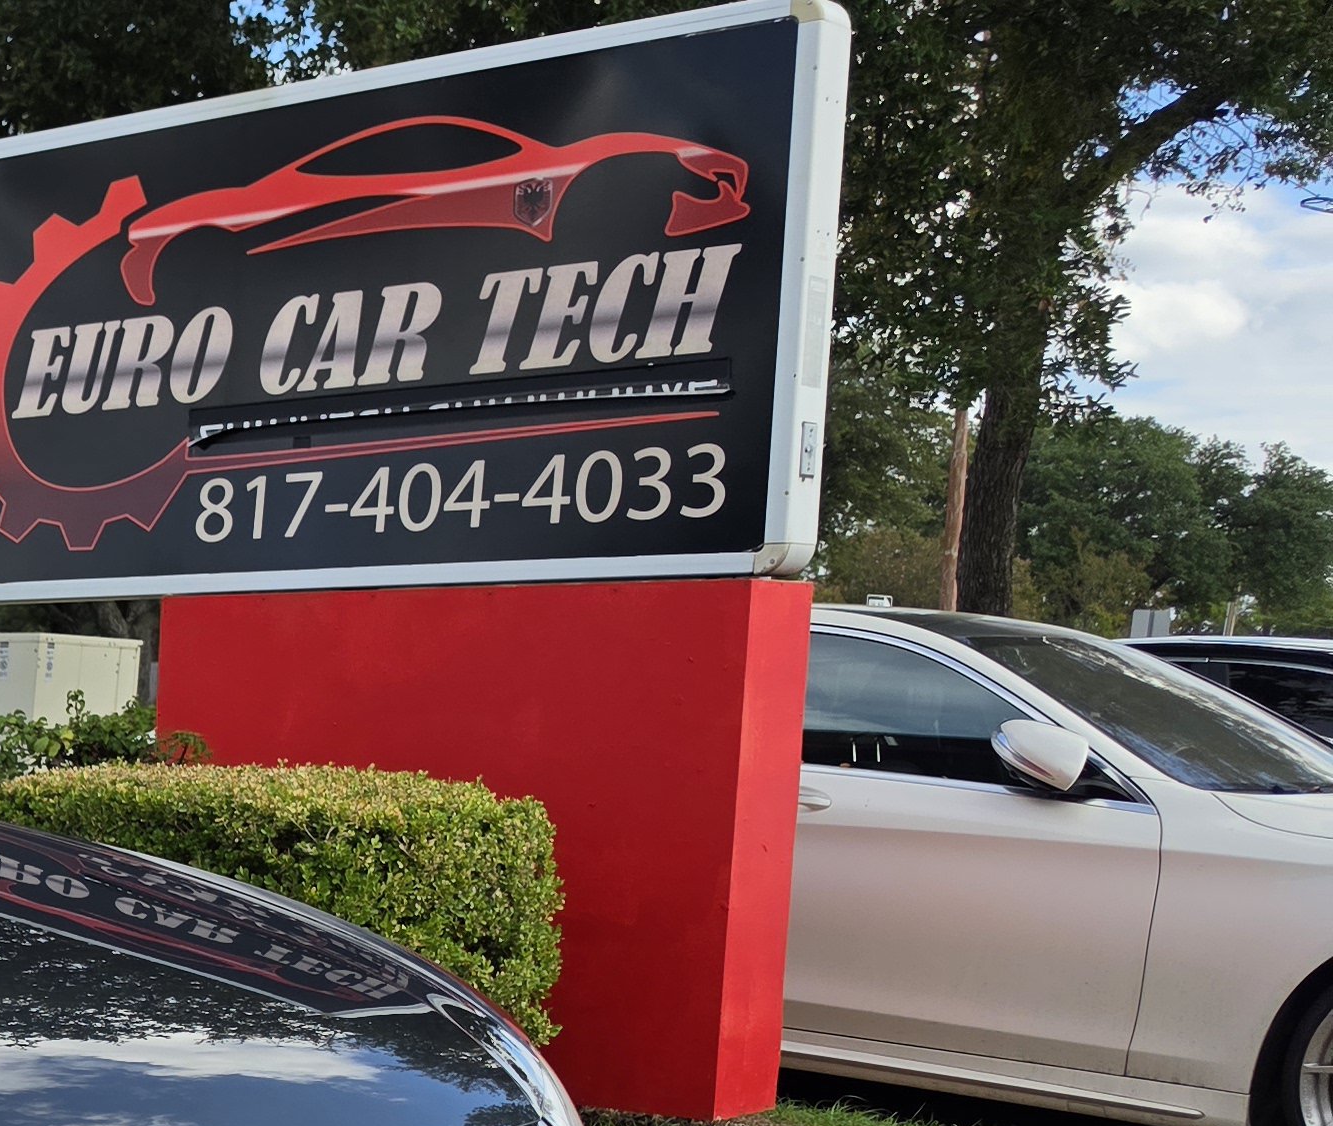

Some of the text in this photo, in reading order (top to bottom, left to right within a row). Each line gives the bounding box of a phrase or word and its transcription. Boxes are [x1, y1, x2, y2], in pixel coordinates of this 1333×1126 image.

[12, 305, 233, 420] EURO
[259, 281, 443, 397] CAR
[469, 243, 743, 375] TECH
[195, 443, 727, 543] 817-404-4033
